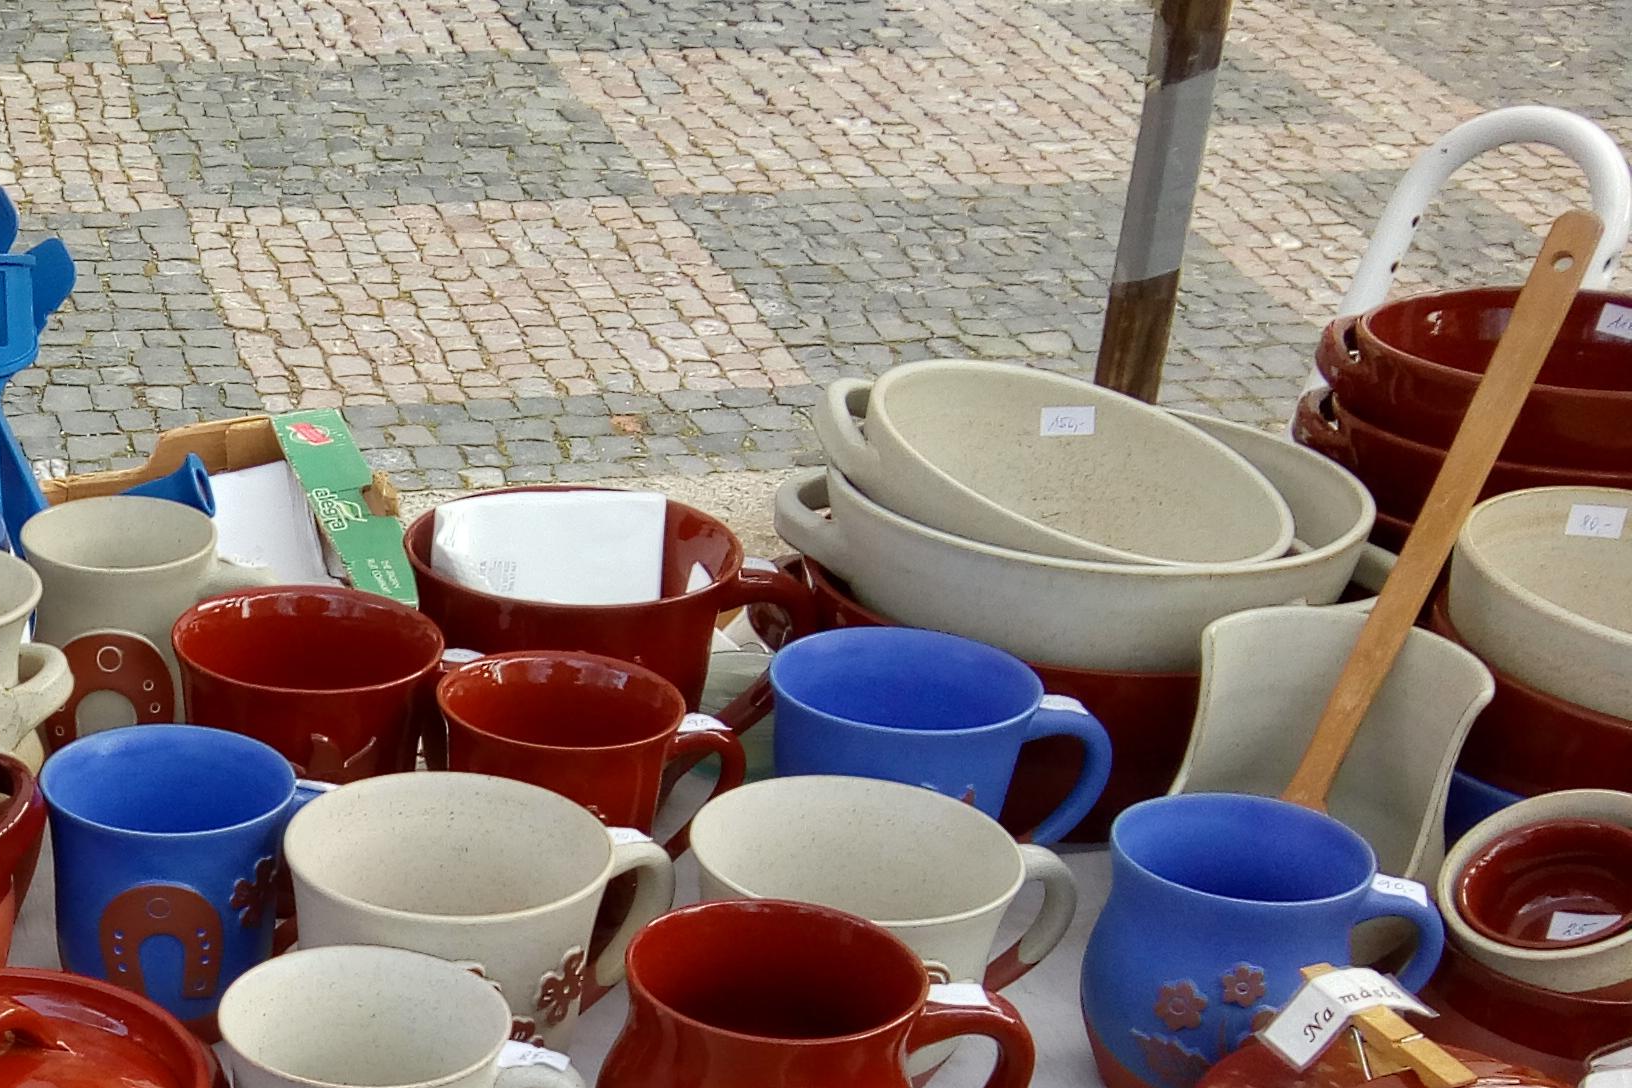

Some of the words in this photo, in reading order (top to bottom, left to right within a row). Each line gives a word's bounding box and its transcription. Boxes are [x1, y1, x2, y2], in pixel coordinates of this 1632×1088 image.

[312, 488, 348, 531] alegra
[1303, 1006, 1335, 1046] Na
[1338, 983, 1403, 1005] máslo
